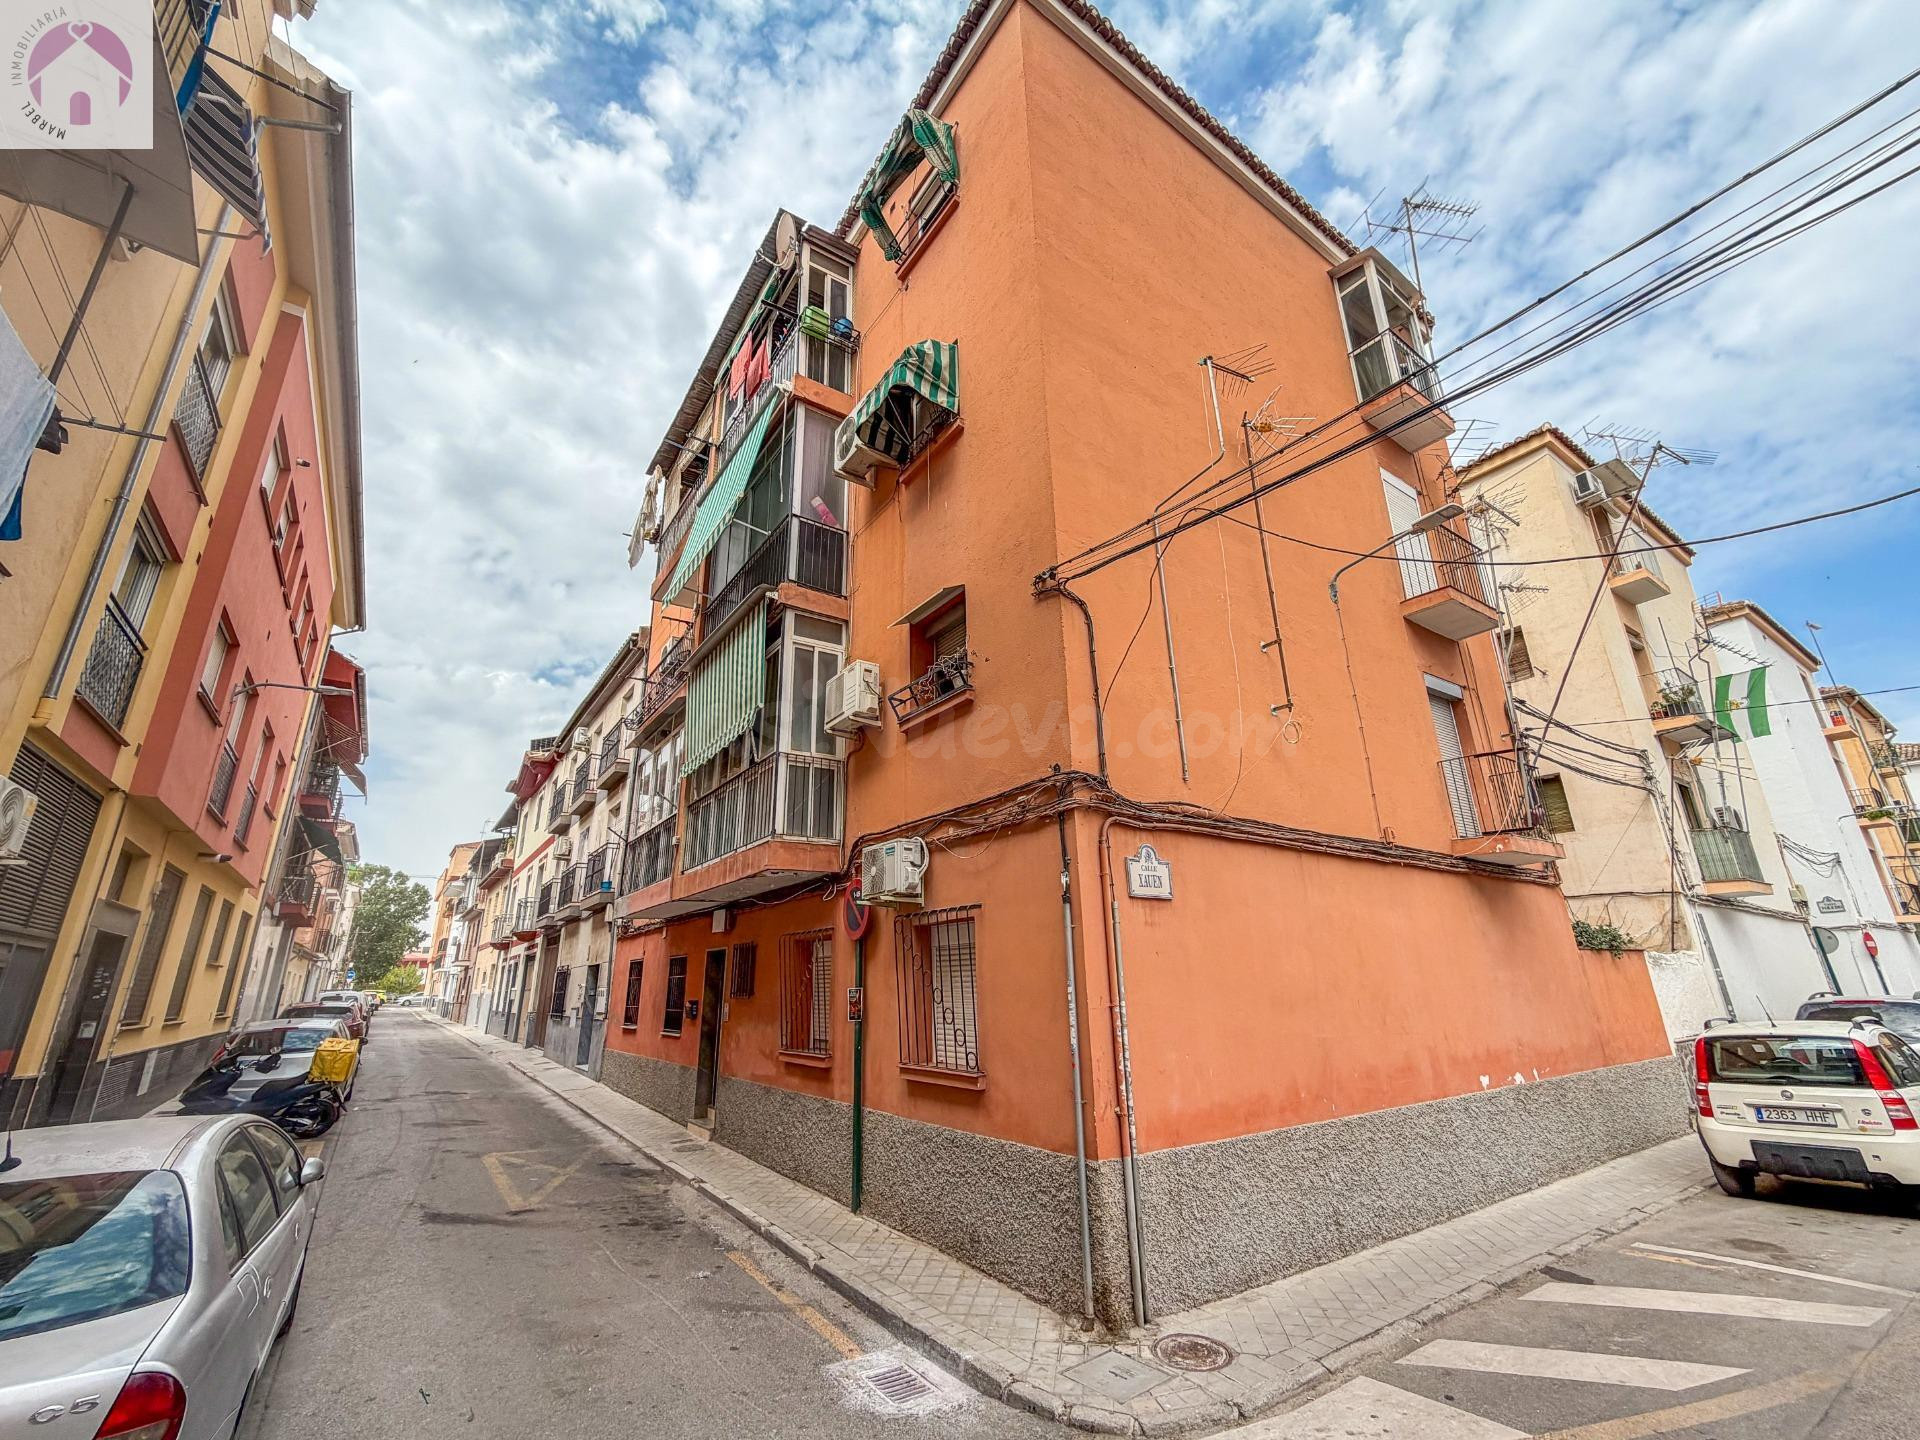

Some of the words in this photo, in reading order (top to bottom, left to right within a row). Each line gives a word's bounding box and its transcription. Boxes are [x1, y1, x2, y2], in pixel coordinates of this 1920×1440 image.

[1141, 864, 1158, 873] CALLE
[1764, 1109, 1798, 1121] 2363
[1804, 1111, 1831, 1123] HHF
[28, 1394, 100, 1425] C5
